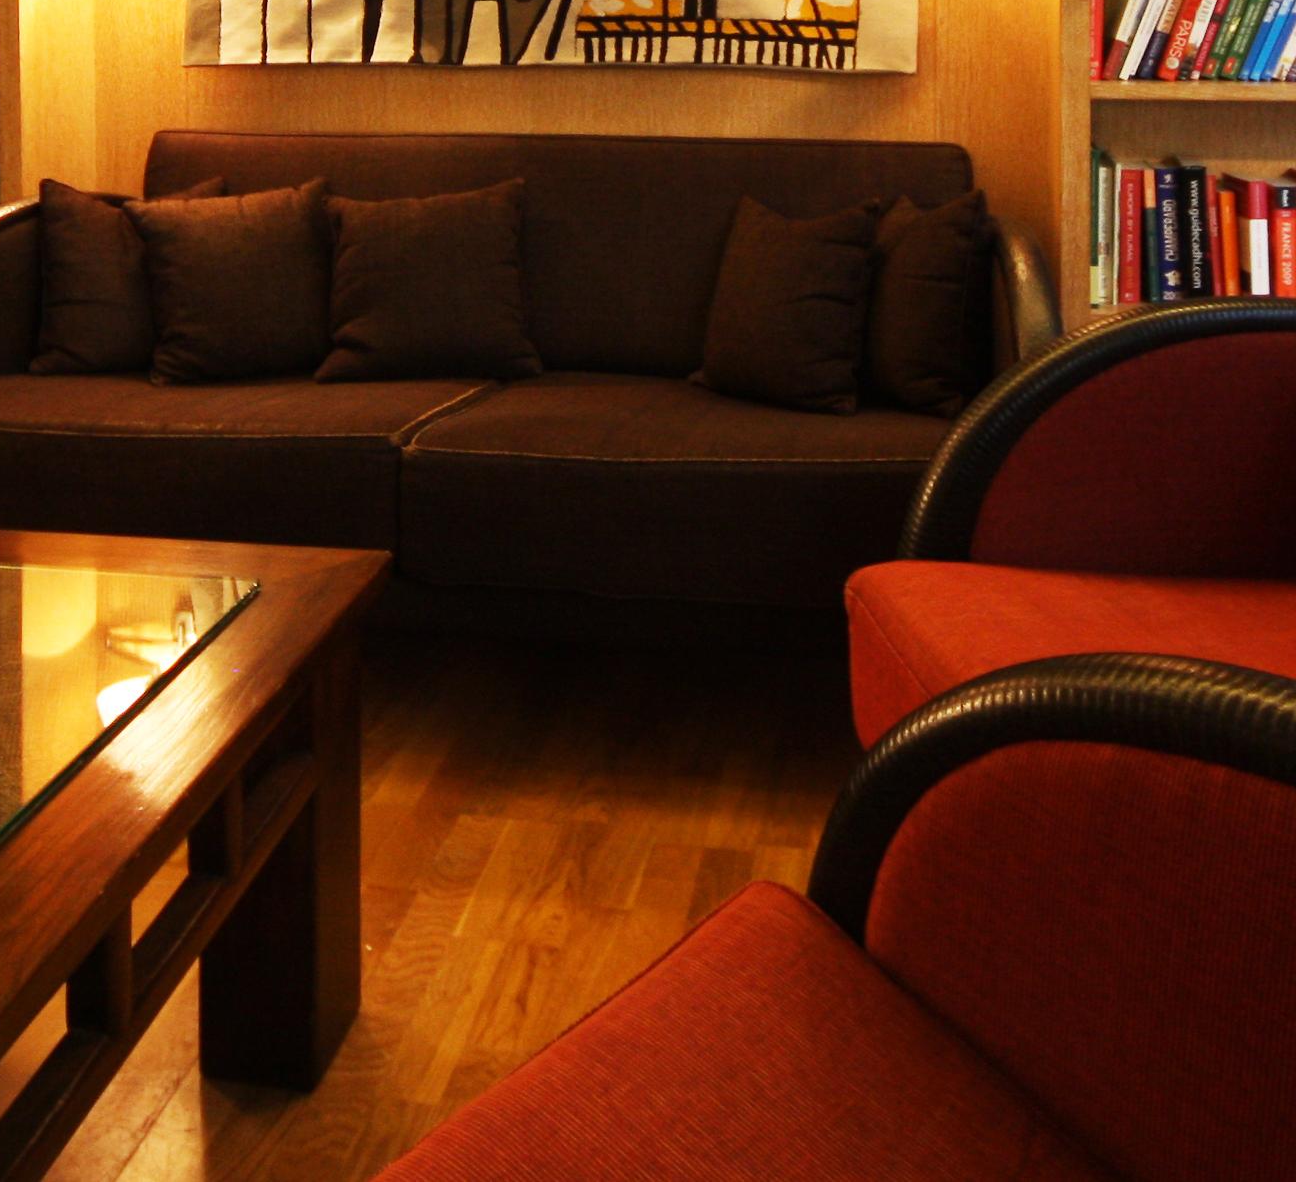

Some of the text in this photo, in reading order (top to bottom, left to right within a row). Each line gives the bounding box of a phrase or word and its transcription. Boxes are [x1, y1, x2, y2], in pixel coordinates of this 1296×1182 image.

[1168, 17, 1192, 59] PARIS
[1281, 222, 1292, 285] FRANCE 2009
